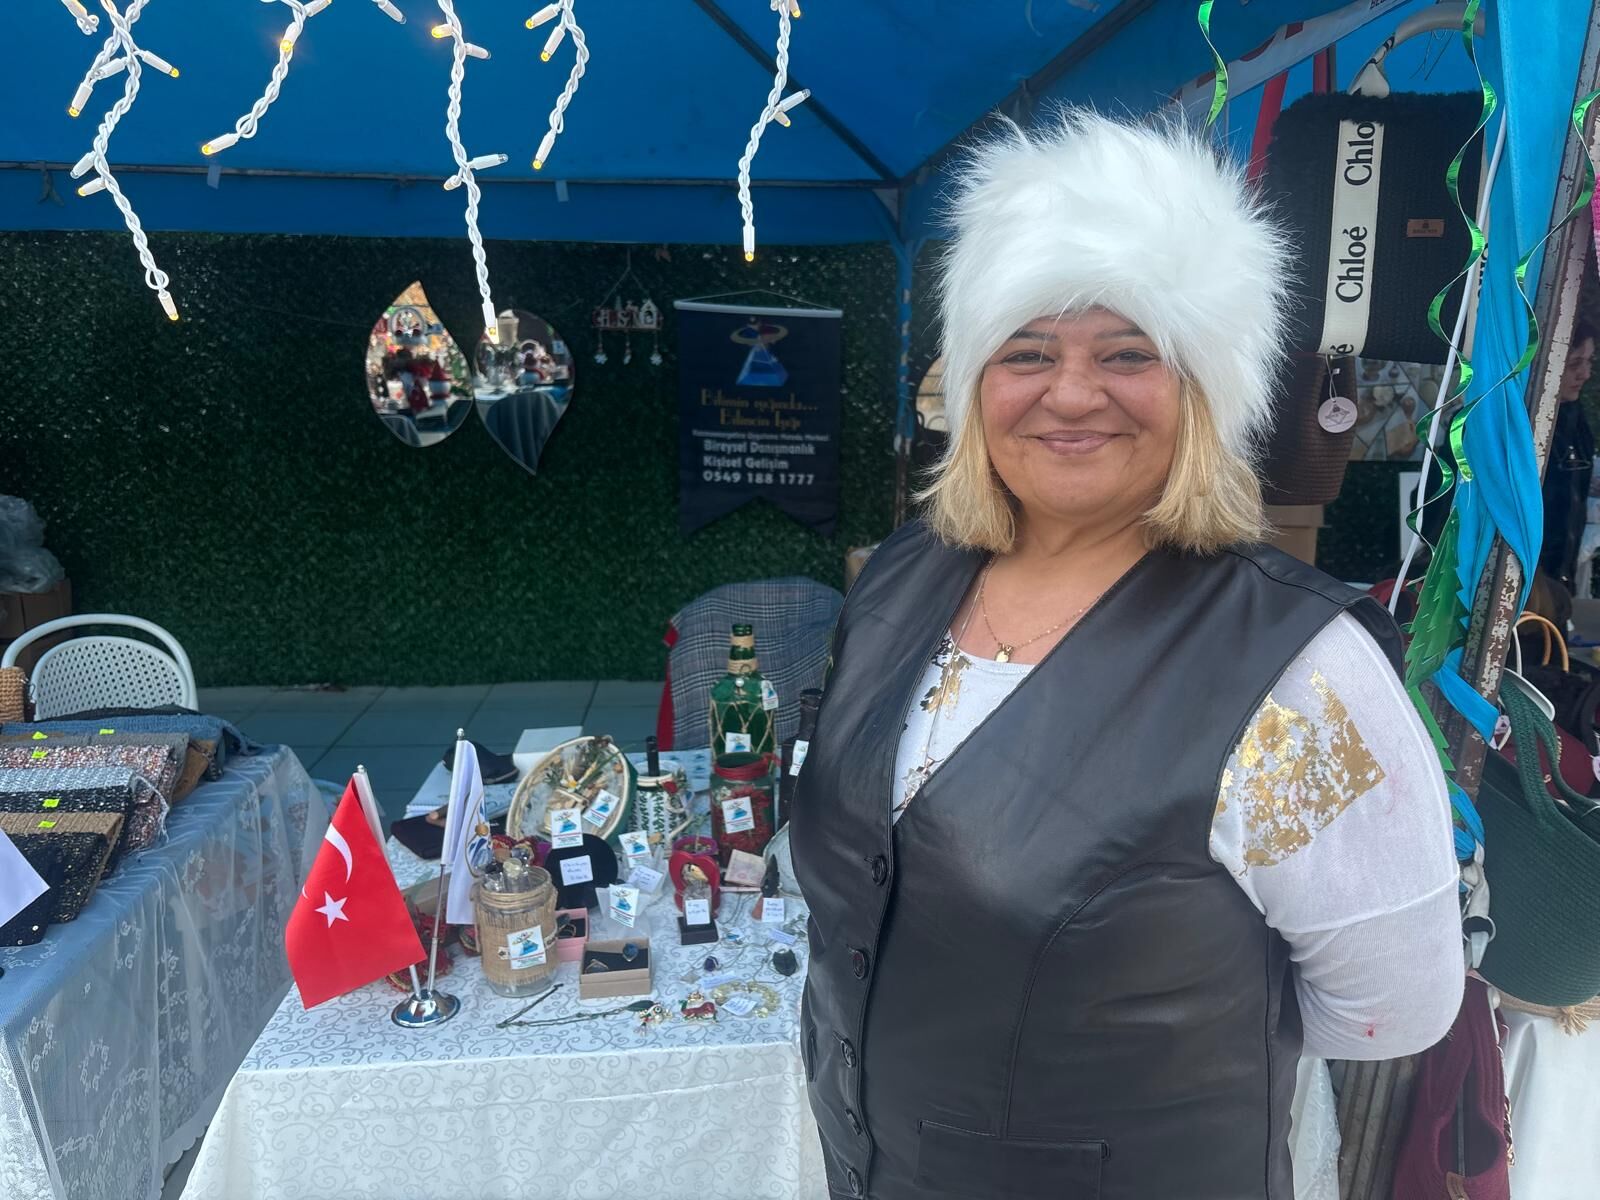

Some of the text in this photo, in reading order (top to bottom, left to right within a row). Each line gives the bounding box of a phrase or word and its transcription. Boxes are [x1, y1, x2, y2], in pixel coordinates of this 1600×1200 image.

[1344, 121, 1376, 186] Chlo
[1335, 226, 1367, 303] Chloé
[703, 440, 816, 457] Bireysel Danışmanlık
[703, 456, 788, 472] Kişisel Gelişim
[702, 470, 815, 485] 0549 188 1777
